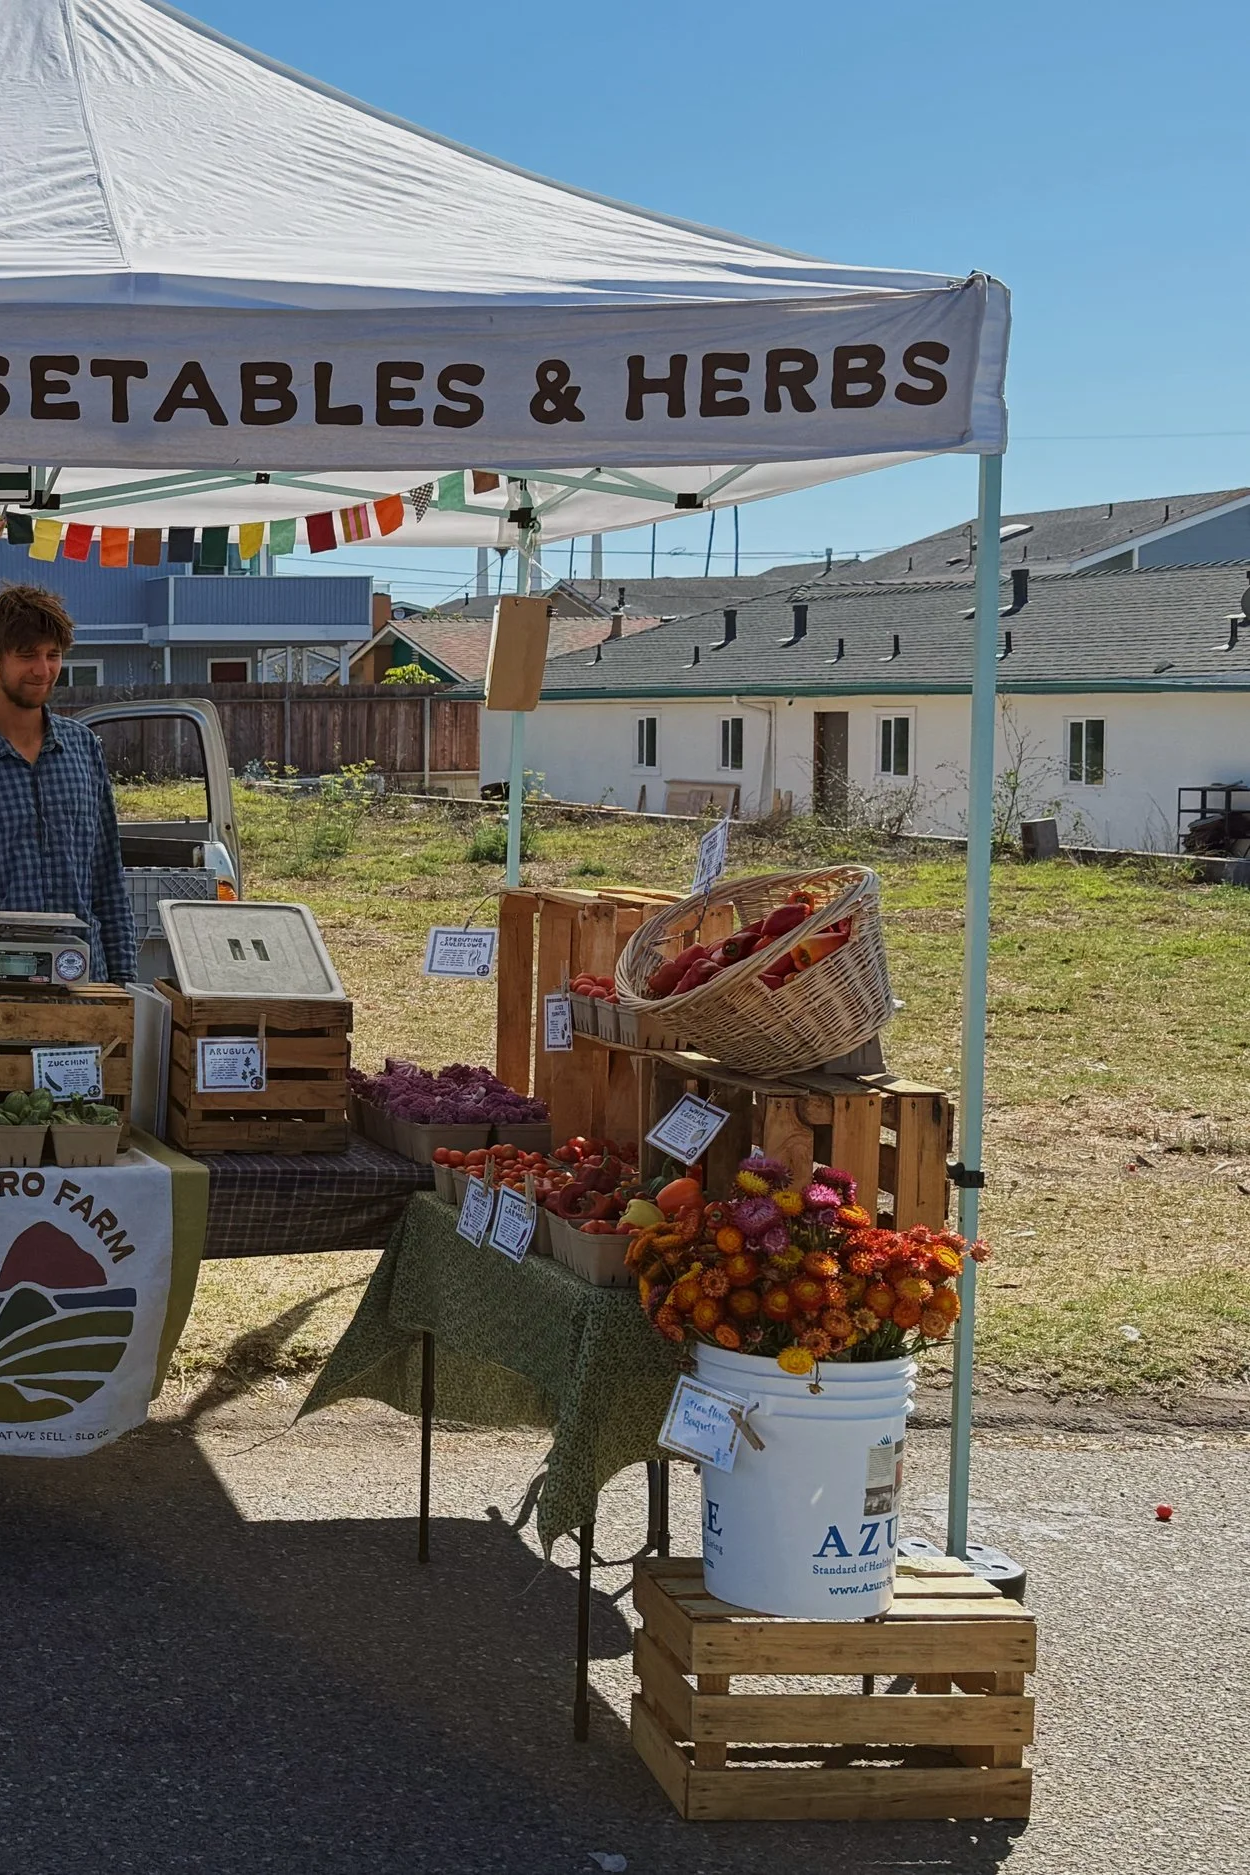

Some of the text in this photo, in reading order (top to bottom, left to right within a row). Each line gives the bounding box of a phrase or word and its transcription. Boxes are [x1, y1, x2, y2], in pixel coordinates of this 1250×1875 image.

[534, 360, 586, 424] &
[627, 340, 952, 420] HERBS
[439, 940, 487, 948] CAULIFLOWER
[209, 1047, 256, 1056] ARUGULA
[47, 1058, 89, 1067] ZUCCHINI
[680, 1109, 709, 1128] EGGPLANT
[688, 1106, 709, 1121] WHITE
[53, 1179, 136, 1264] FARM
[15, 1431, 36, 1441] WE
[40, 1432, 66, 1441] SELL
[812, 1564, 857, 1575] Standard
[858, 1562, 869, 1572] of
